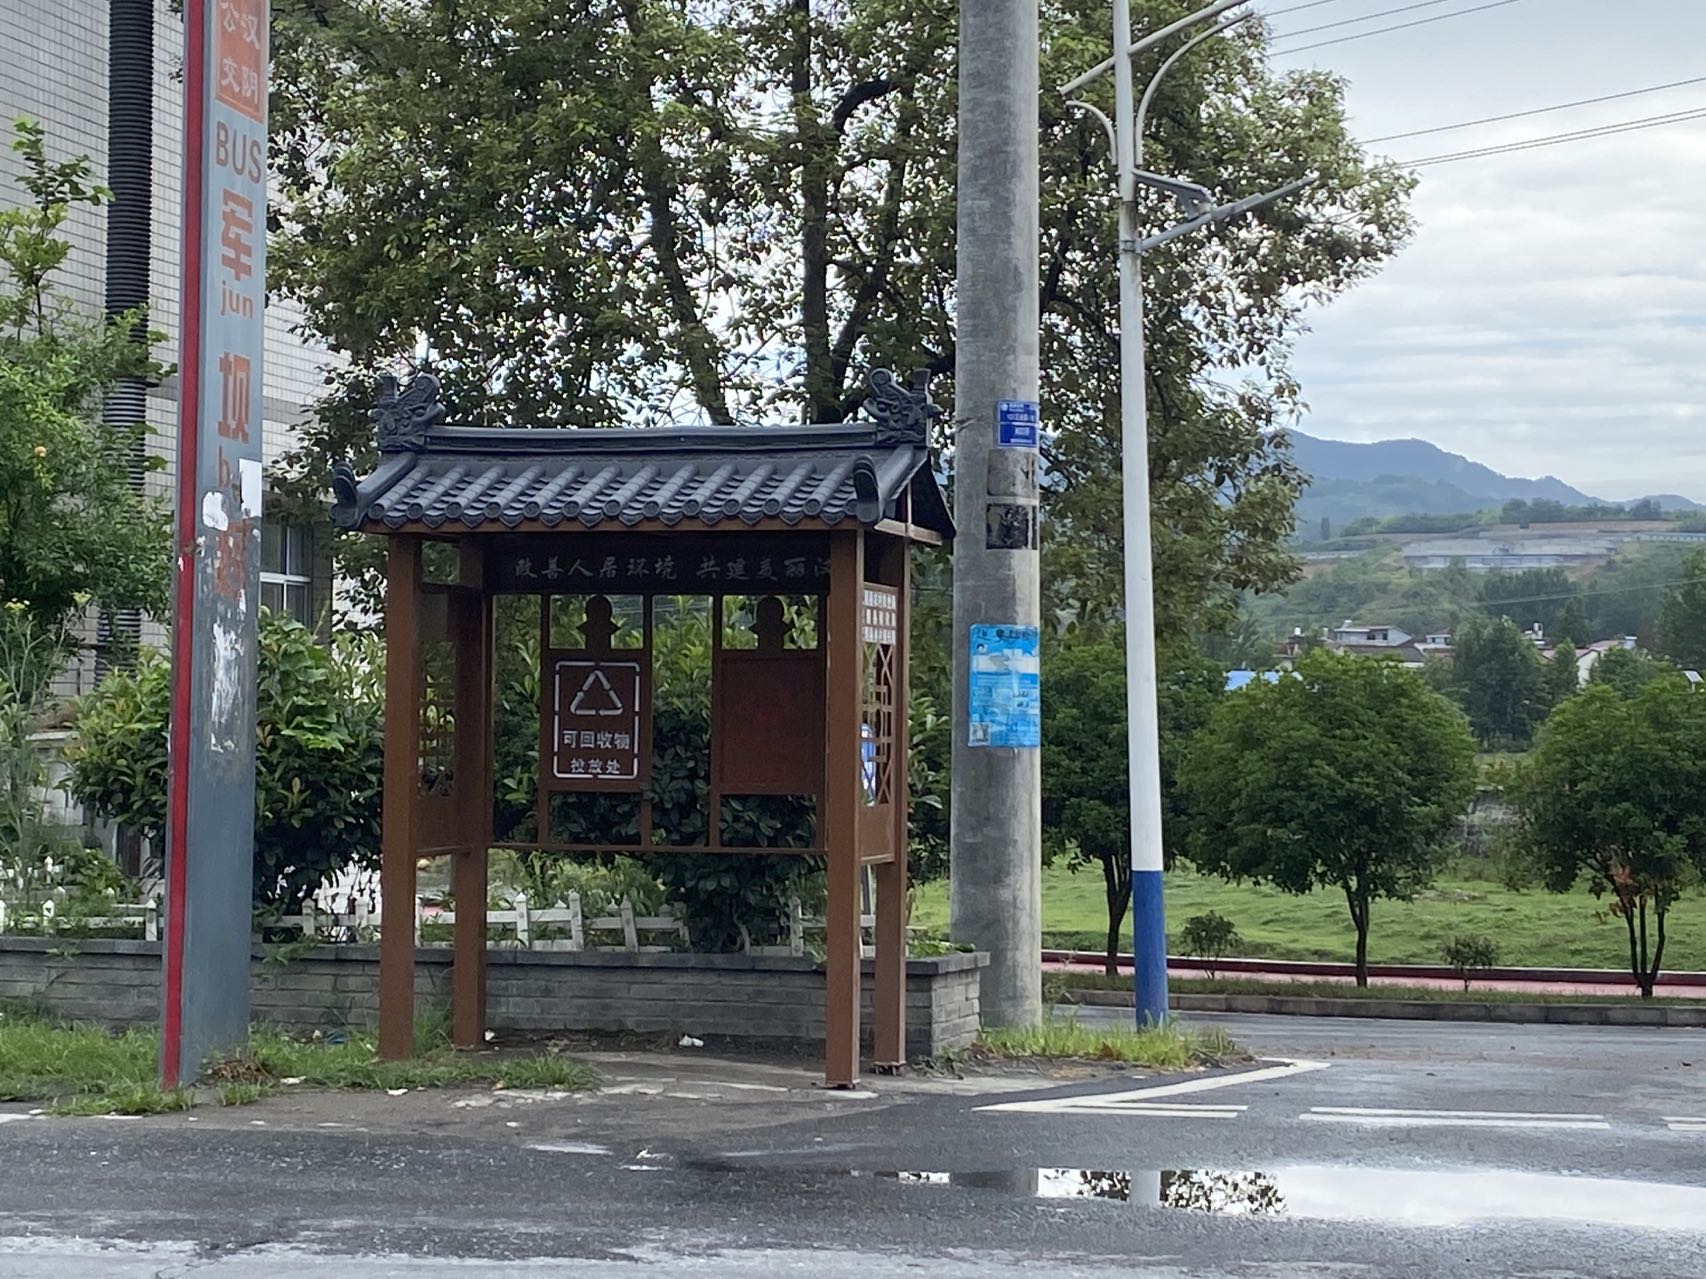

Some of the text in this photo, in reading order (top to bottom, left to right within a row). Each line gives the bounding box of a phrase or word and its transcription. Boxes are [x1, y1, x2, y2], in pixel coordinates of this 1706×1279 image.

[215, 120, 262, 185] BUS
[221, 188, 253, 282] 军
[220, 279, 254, 320] jun
[217, 350, 251, 444] 坝
[562, 730, 630, 750] 可回收物
[570, 757, 621, 774] 投放处
